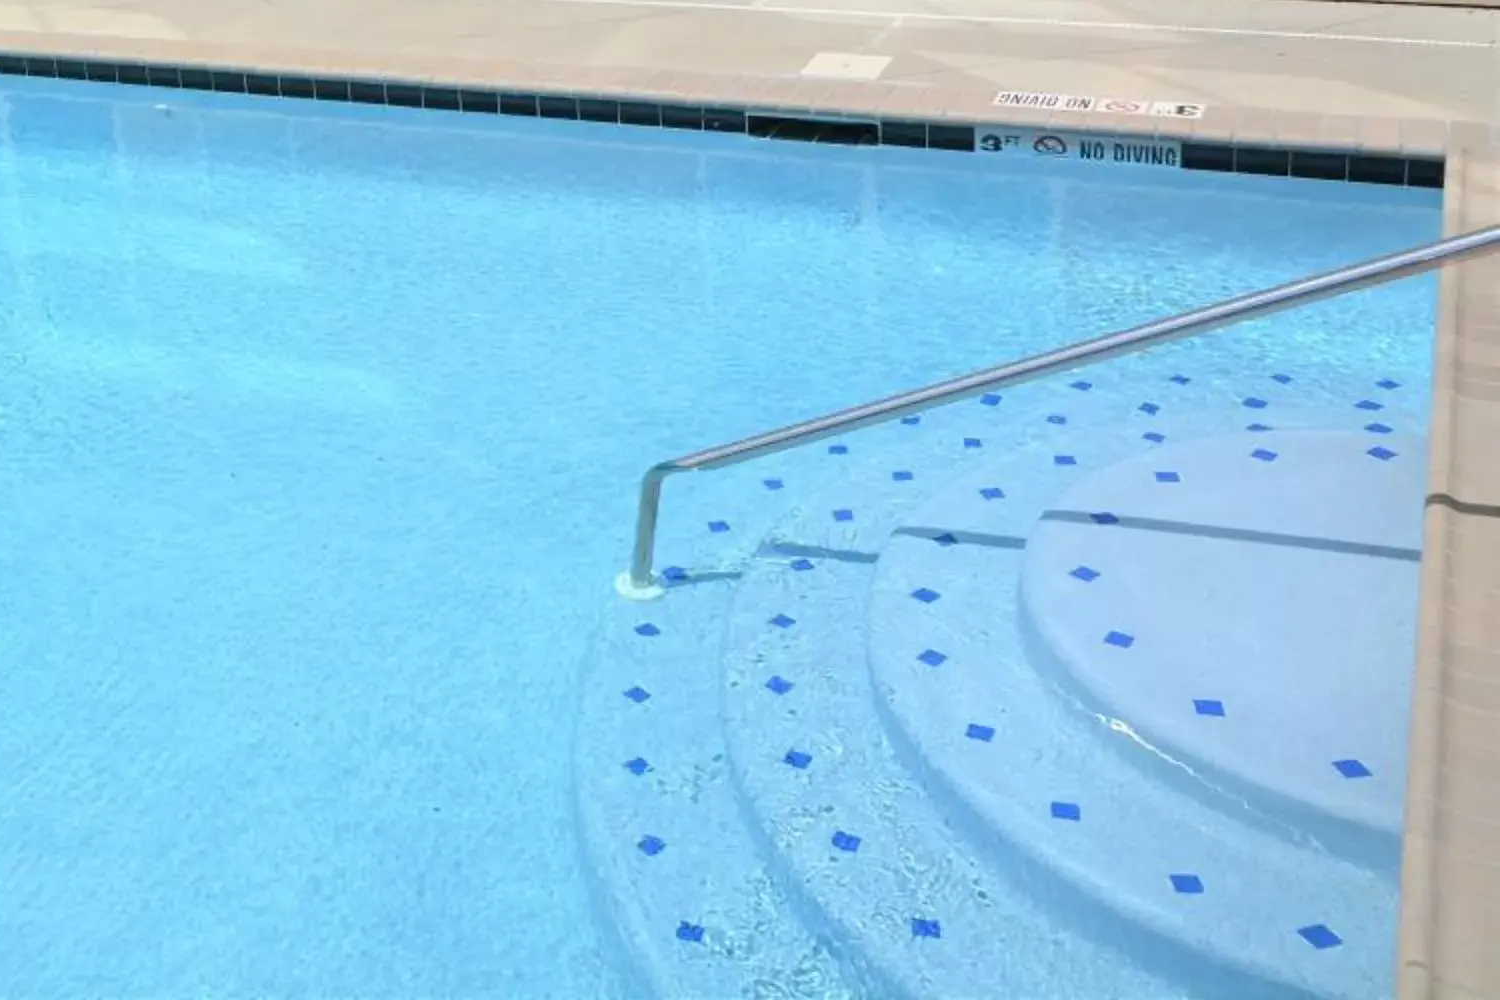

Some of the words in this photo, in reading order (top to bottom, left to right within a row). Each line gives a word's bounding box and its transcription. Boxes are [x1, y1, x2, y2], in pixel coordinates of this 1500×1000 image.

[999, 91, 1059, 108] DIVING
[1066, 97, 1093, 110] NO
[980, 133, 1003, 153] 3
[1078, 138, 1105, 160] NO
[1113, 142, 1179, 167] DIVING
